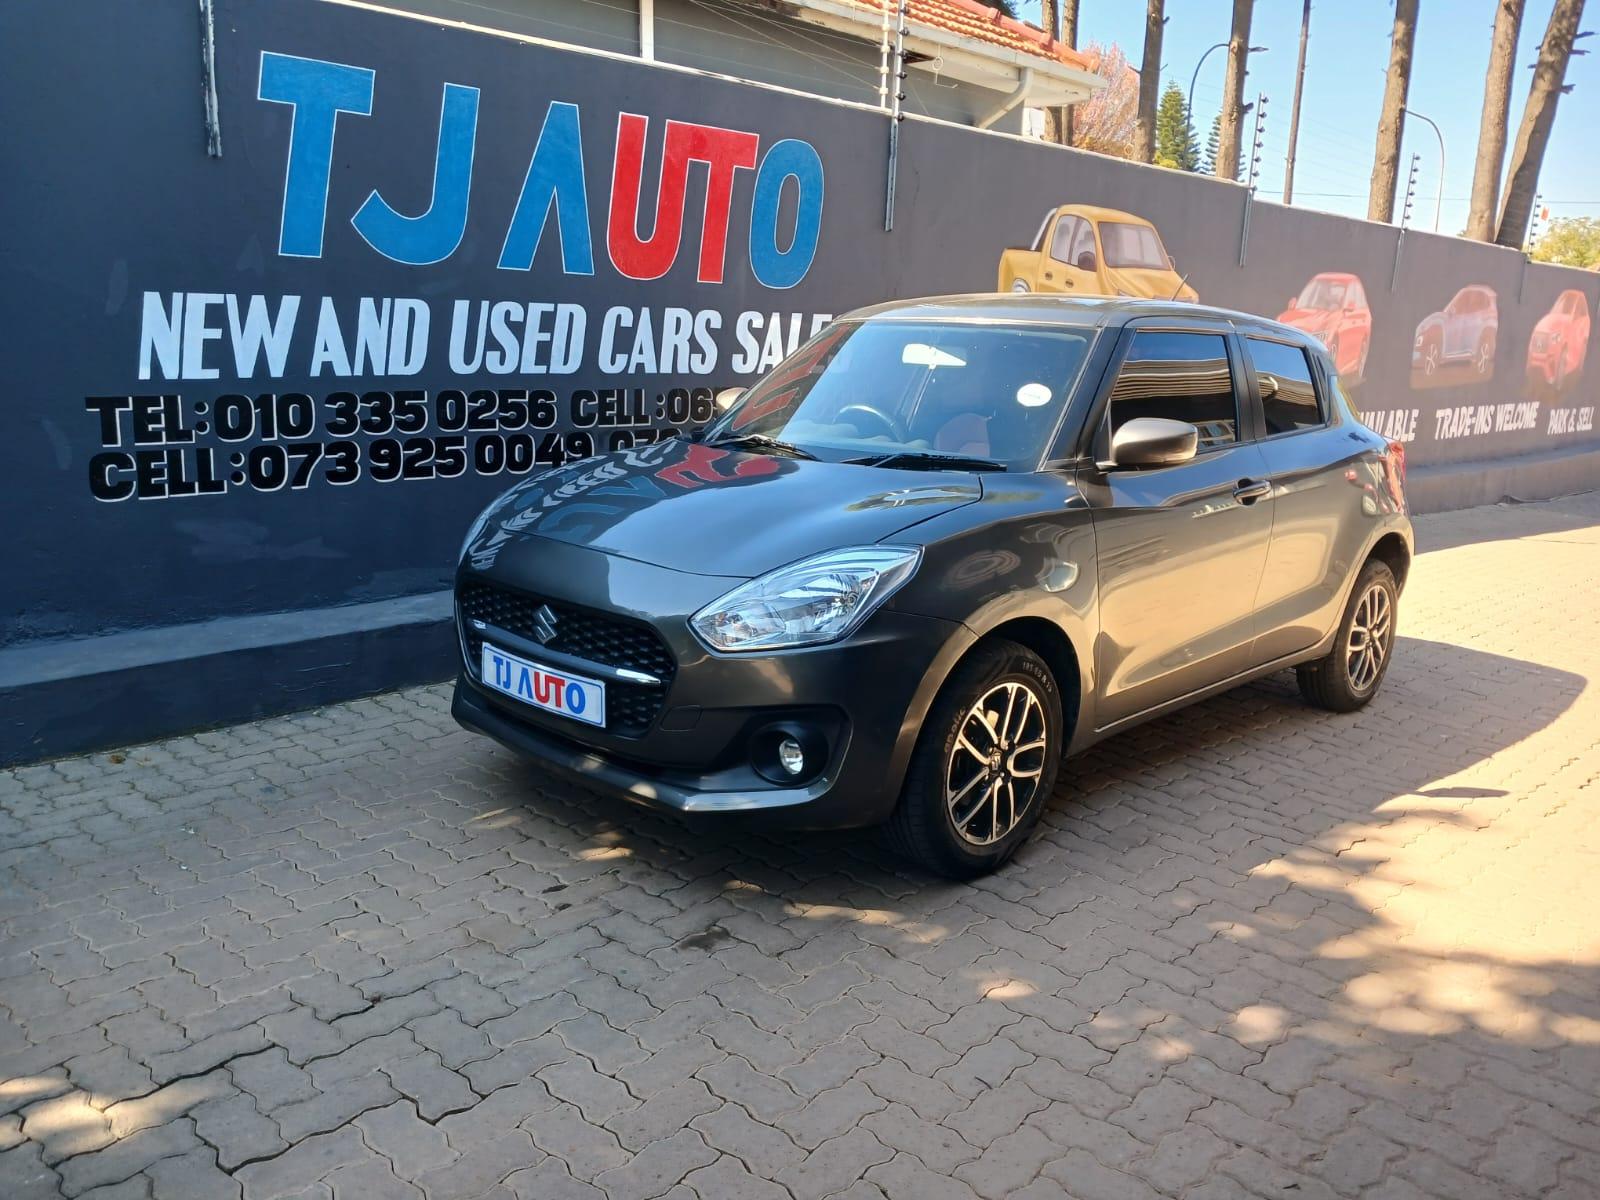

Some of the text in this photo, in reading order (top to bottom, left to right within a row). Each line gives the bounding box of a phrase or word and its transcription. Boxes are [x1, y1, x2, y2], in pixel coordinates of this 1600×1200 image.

[257, 51, 824, 289] TJ AUTO
[138, 291, 301, 380] NEW
[310, 296, 431, 377] AND
[448, 299, 587, 375] USED
[598, 306, 722, 374] CARS
[324, 390, 428, 437] 335
[436, 389, 557, 434] 0256
[1435, 401, 1540, 440] TRADE-INS WELCOME
[1547, 408, 1570, 435] PARK
[1577, 406, 1595, 431] SELL
[369, 436, 467, 480] 925
[474, 432, 595, 476] 0049
[493, 655, 586, 715] TJ AUTO
